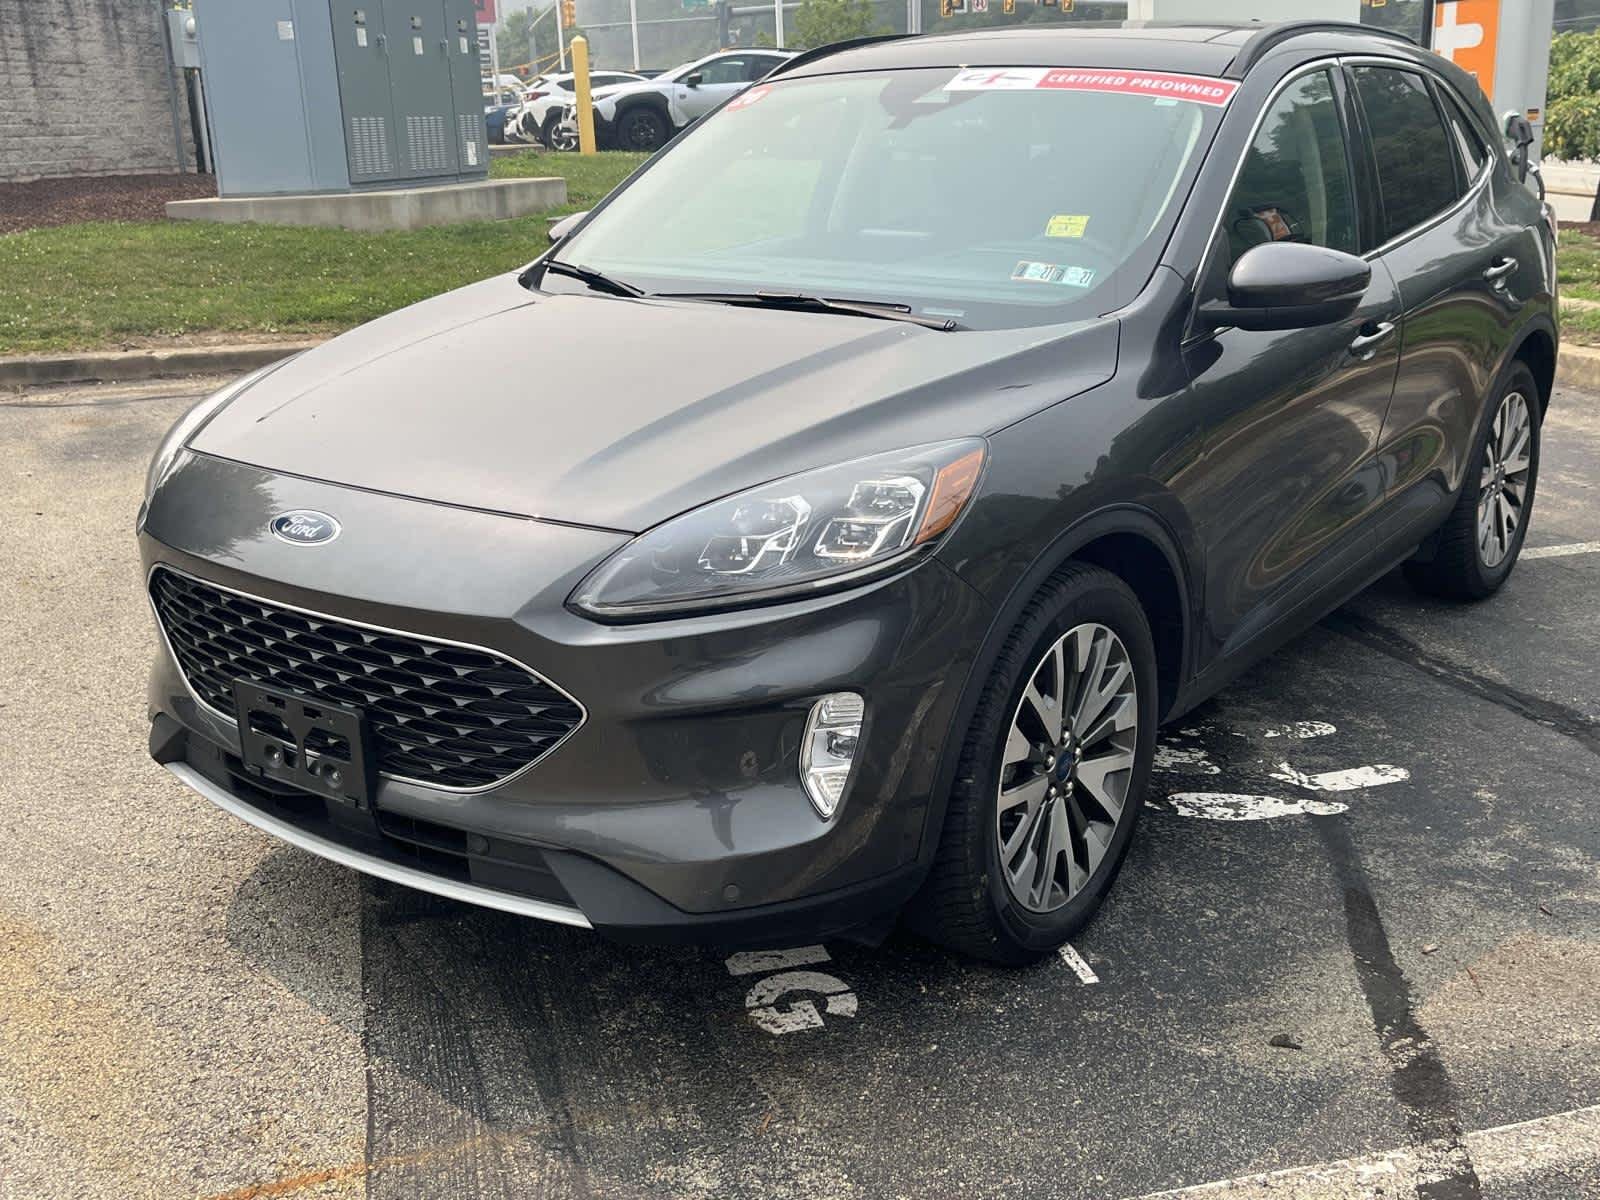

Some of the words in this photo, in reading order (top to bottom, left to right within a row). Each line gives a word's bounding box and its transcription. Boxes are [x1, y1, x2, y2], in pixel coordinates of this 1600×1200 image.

[1047, 72, 1126, 87] CERTIFIED
[1129, 77, 1225, 98] PREOWNED
[281, 514, 324, 538] Ford
